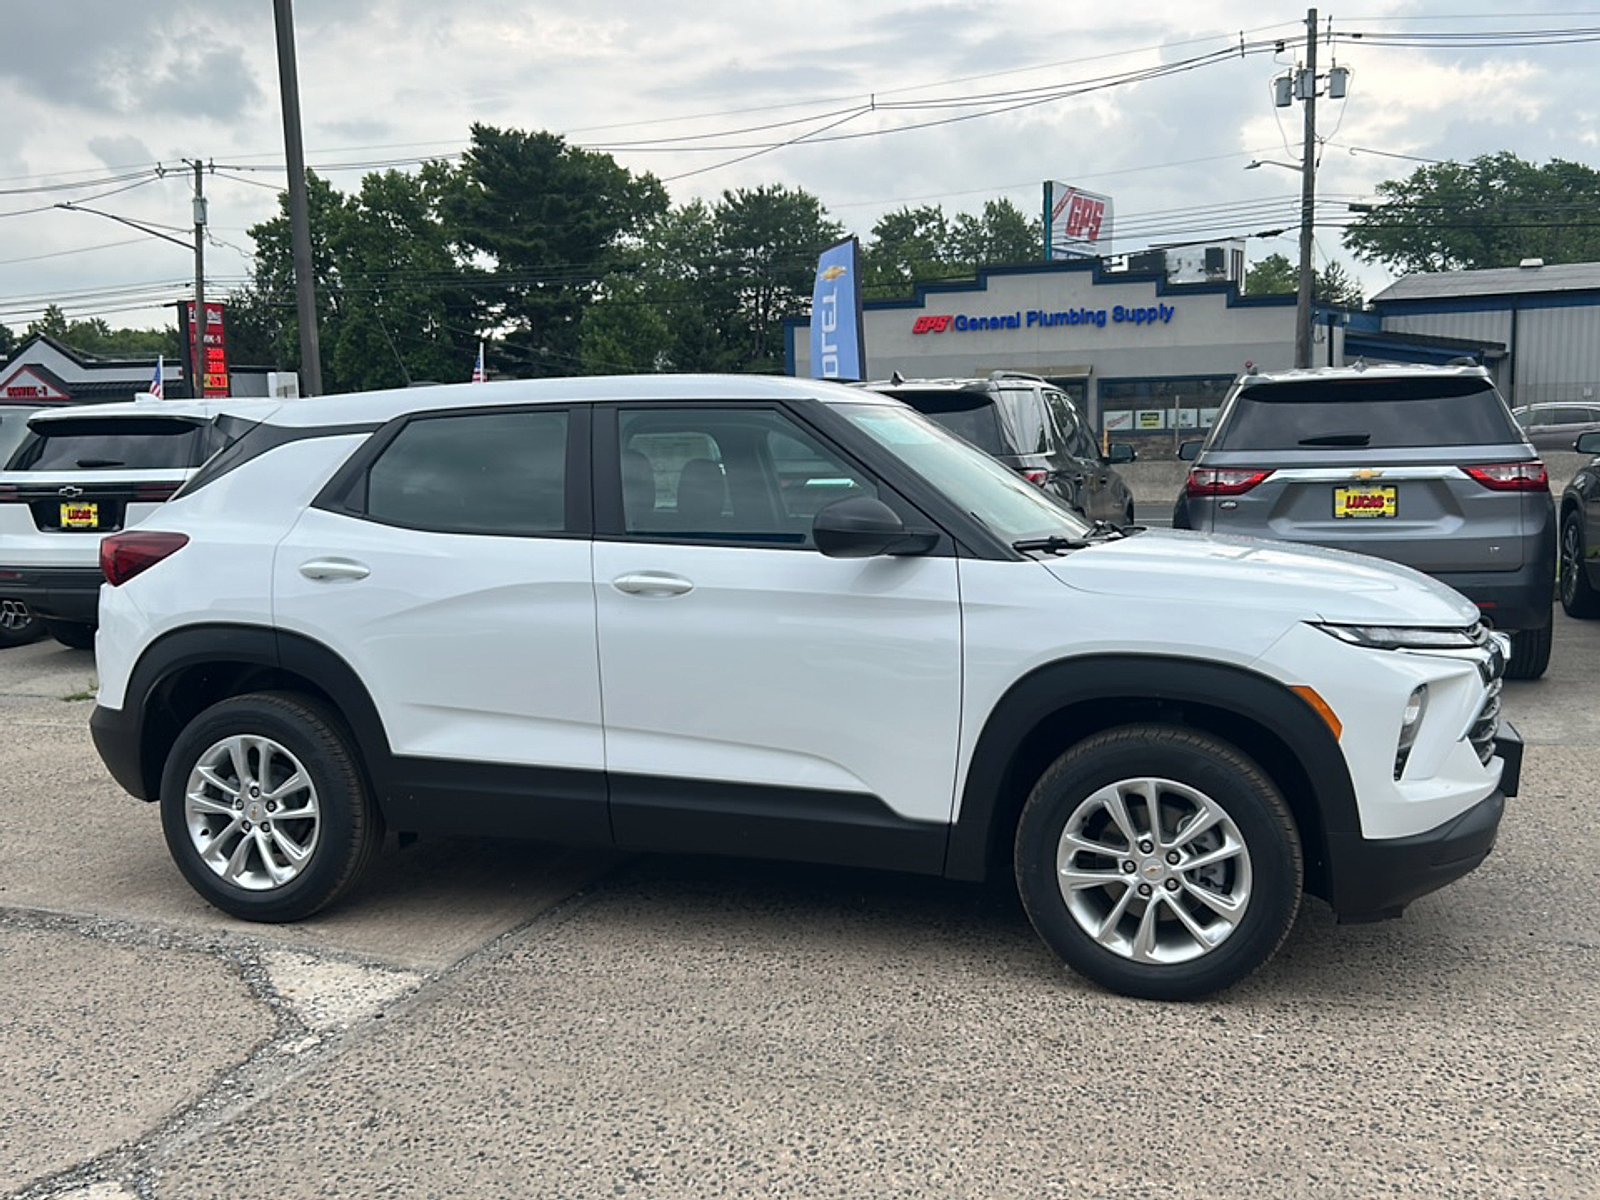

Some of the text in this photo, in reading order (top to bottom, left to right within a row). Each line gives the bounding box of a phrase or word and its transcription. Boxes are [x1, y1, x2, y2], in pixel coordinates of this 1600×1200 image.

[1065, 196, 1105, 241] GPS
[912, 302, 1175, 335] GPS General Plumbing Supply
[1346, 494, 1385, 509] LUCAS
[68, 508, 92, 520] LUCAS
